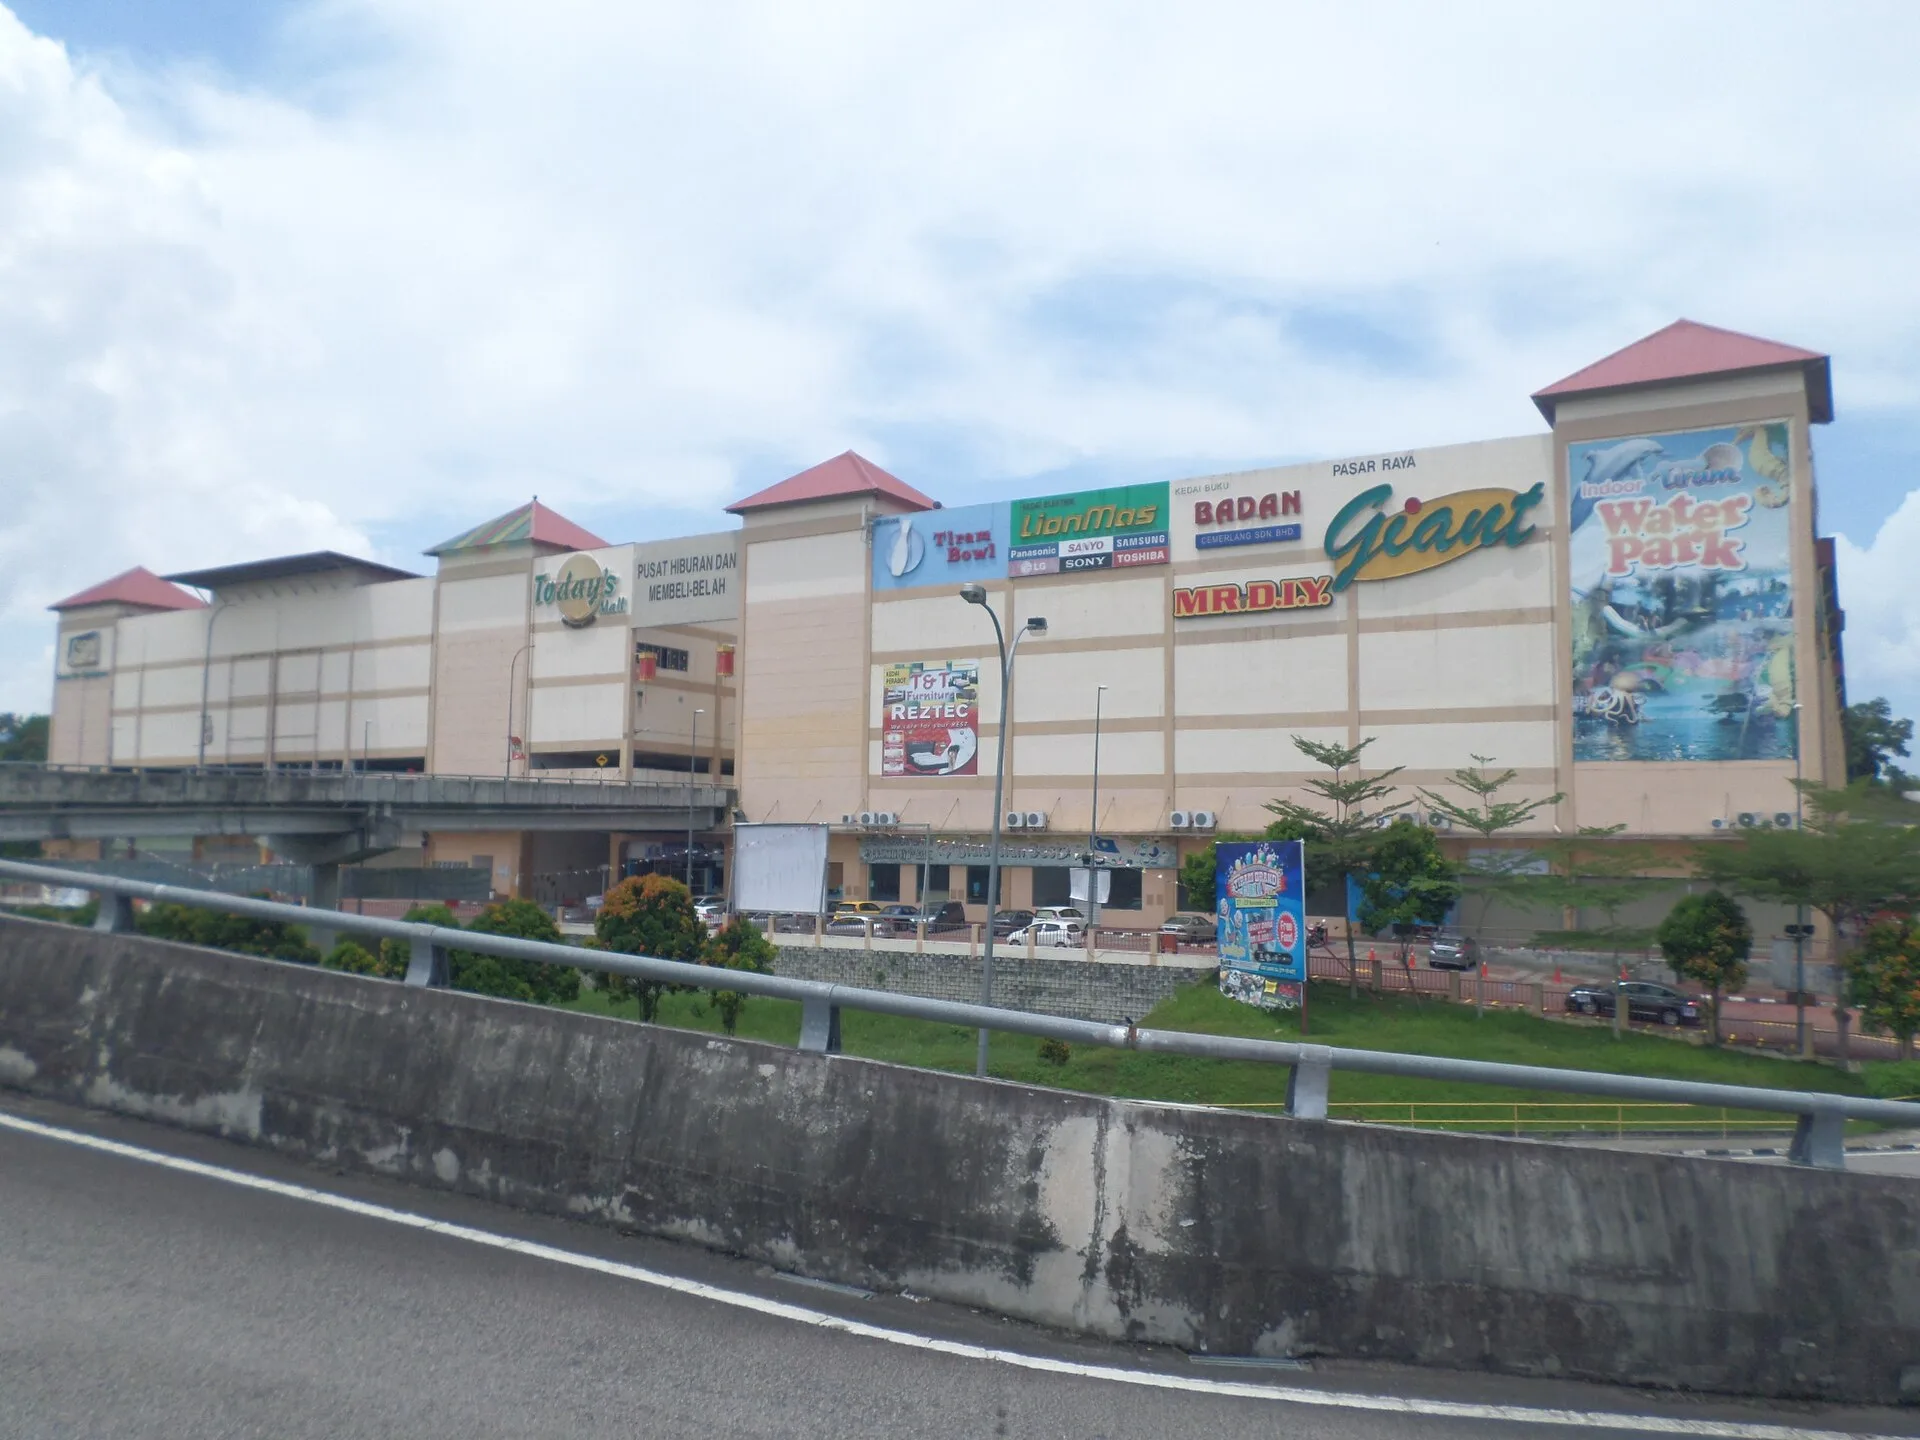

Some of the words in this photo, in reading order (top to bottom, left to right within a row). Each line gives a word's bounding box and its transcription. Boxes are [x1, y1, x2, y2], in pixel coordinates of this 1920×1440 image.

[1333, 460, 1376, 476] PASAR
[1382, 456, 1416, 471] RAYA
[1204, 482, 1230, 492] BUKU
[1582, 480, 1643, 498] Indoor
[1194, 489, 1301, 525] BADAN
[1597, 493, 1752, 535] Water
[1020, 503, 1159, 538] LionMas
[1116, 534, 1165, 548] SAMSUNG
[1201, 532, 1251, 545] CEMERLANG
[1254, 529, 1272, 538] SDN
[1324, 482, 1545, 592] Giant
[947, 543, 996, 563] Bowl
[1010, 546, 1057, 559] Panasonic
[1067, 540, 1104, 553] SANYO
[1607, 530, 1745, 574] Park
[637, 559, 668, 579] PUSAT
[670, 555, 713, 575] HIBURAN
[715, 552, 737, 569] DAN
[1065, 556, 1106, 568] SONY
[1117, 550, 1165, 563] TOSHIBA
[535, 568, 618, 607] Today's
[649, 578, 726, 602] MEMBELI-BELAH
[600, 597, 628, 614] Mall
[906, 690, 955, 701] Furniture
[890, 704, 969, 720] REZTEC
